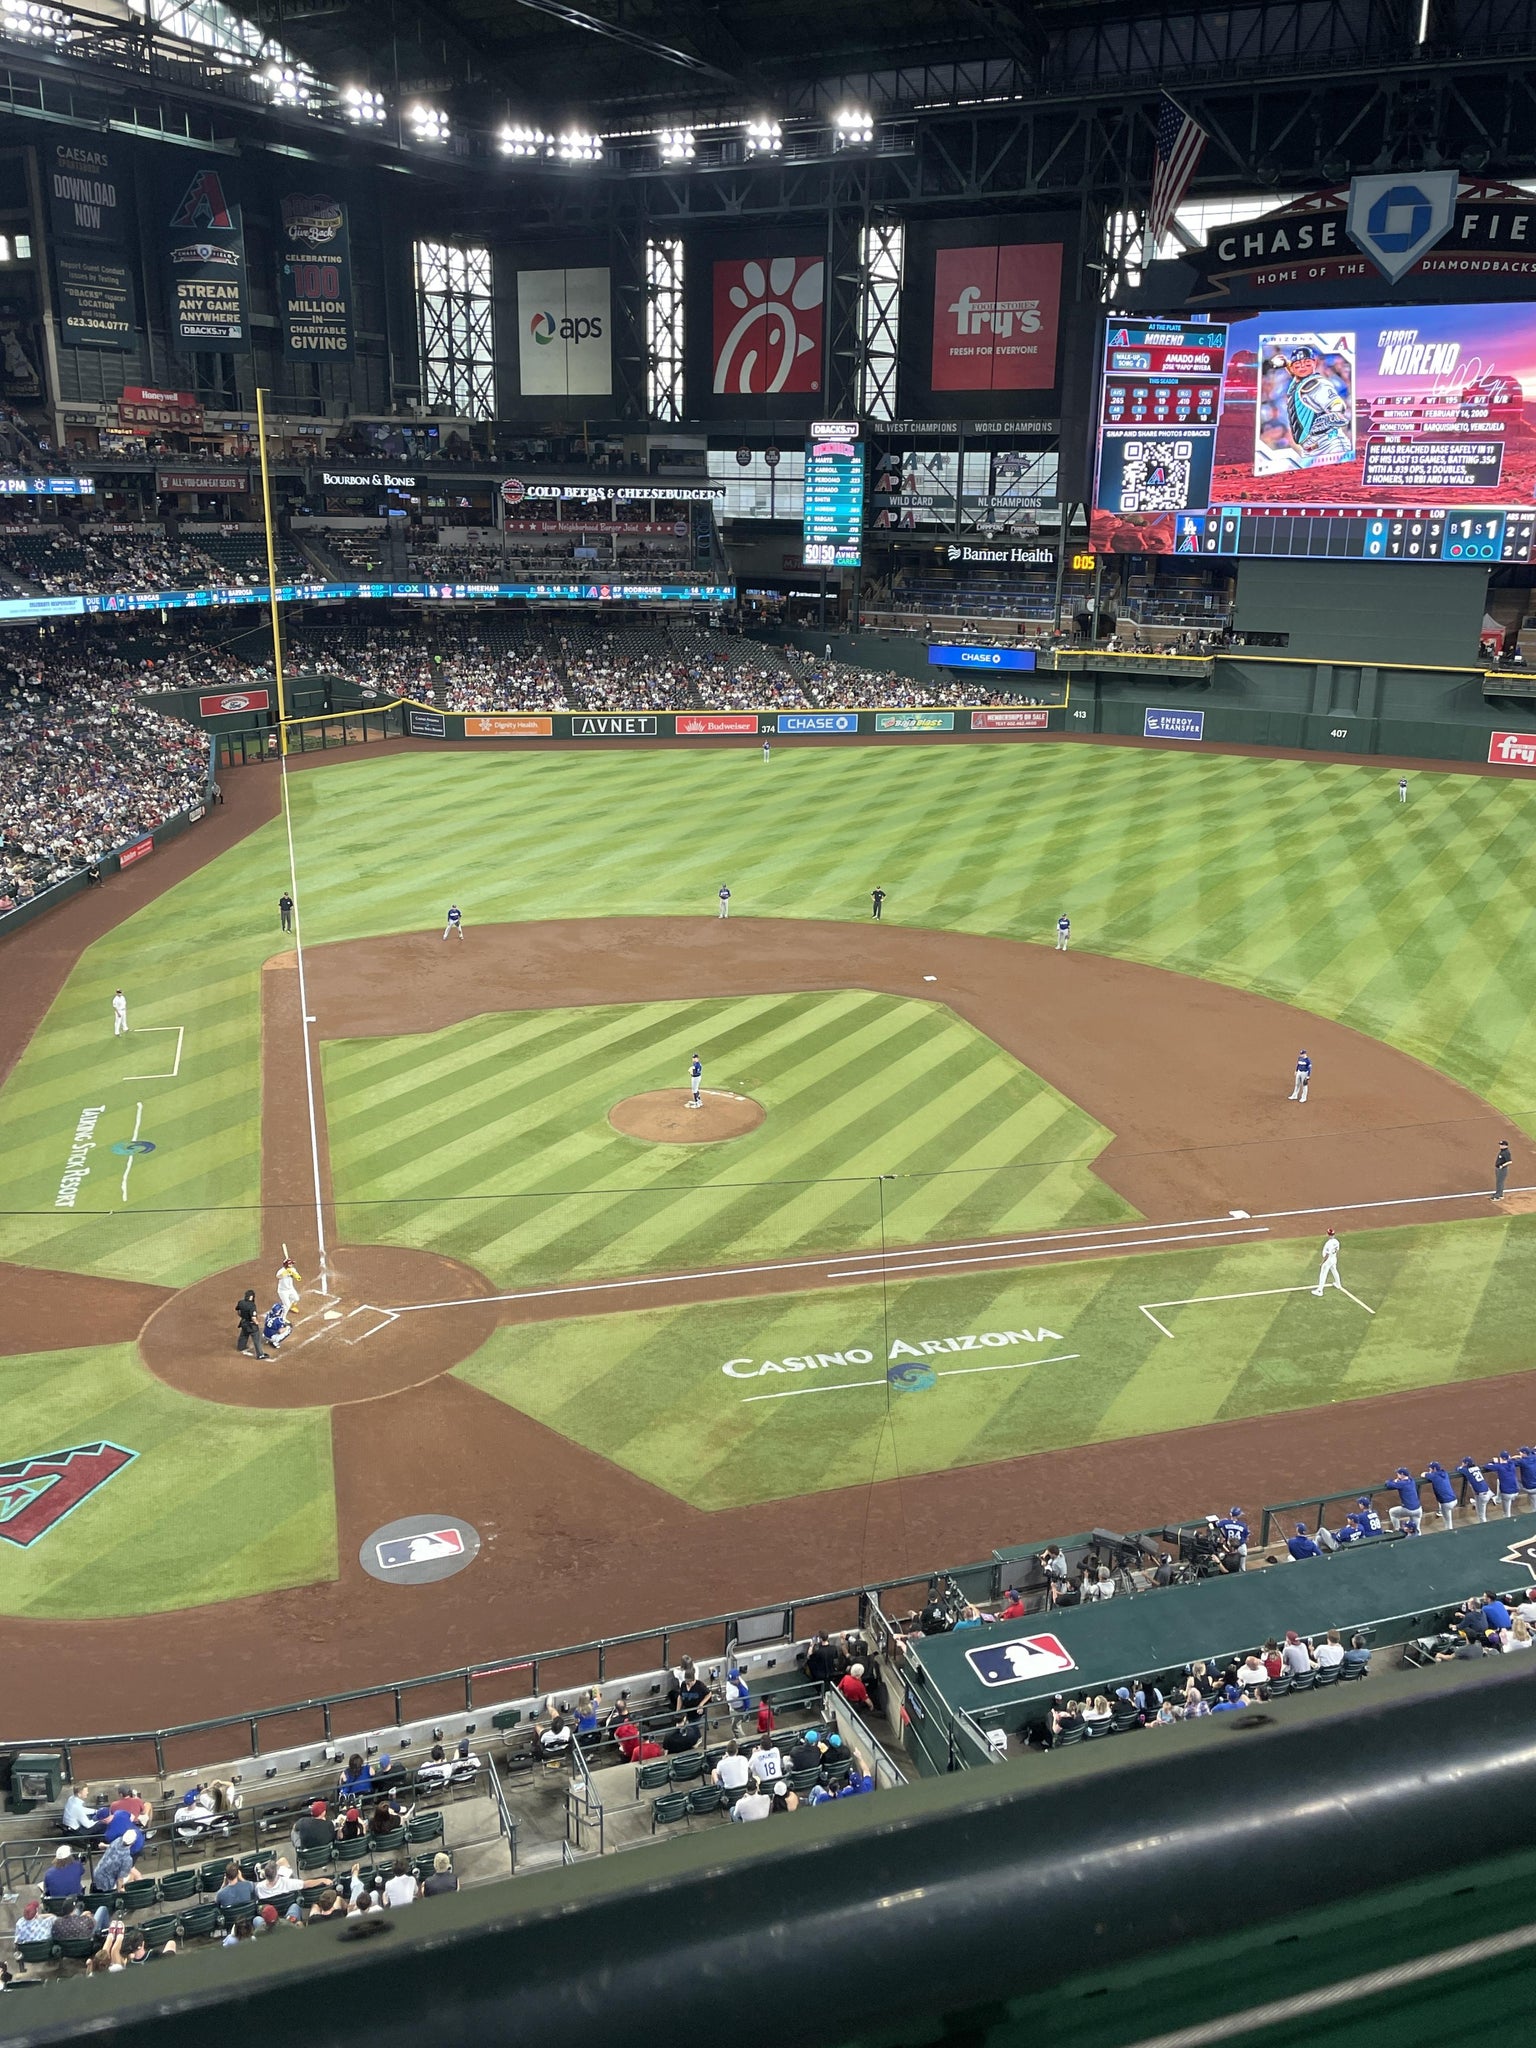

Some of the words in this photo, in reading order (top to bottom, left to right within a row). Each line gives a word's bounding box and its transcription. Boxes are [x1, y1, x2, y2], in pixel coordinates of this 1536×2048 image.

[56, 145, 109, 167] CAESARS
[53, 174, 117, 207] DOWNLOAD
[74, 203, 100, 229] NOW
[309, 226, 334, 242] Back
[1218, 222, 1336, 261] CHASE
[285, 254, 342, 263] CELEBRATING
[1257, 270, 1297, 284] HOME
[1309, 267, 1326, 277] OF
[1338, 264, 1365, 275] THE
[1422, 260, 1536, 272] DIAMONDBACKS
[177, 285, 239, 299] STREAM
[78, 299, 116, 310] LOCATION
[178, 300, 204, 310] ANY
[206, 300, 240, 311] GAME
[288, 301, 346, 313] MILLION
[1001, 301, 1036, 309] STORES
[180, 312, 241, 323] ANYWHERE
[312, 315, 324, 324] IN
[66, 317, 129, 331] 623.304.0777
[559, 315, 602, 344] aps
[183, 326, 227, 336] DBACKS.TV
[290, 325, 347, 335] CHARITABLE
[291, 336, 348, 351] GIVING
[1144, 333, 1185, 346] MORENO
[1207, 333, 1223, 348] 14
[1378, 330, 1418, 348] GABRIEL
[949, 347, 974, 356] FRESH
[976, 347, 993, 355] FOR
[995, 345, 1038, 355] EVERYONE
[1165, 354, 1194, 363] AMADO
[1378, 342, 1460, 376] MORENO
[141, 390, 178, 402] Honeywell
[1445, 396, 1458, 404] 195
[874, 423, 884, 432] NL
[887, 423, 907, 432] WEST
[911, 424, 957, 432] CHAMPIONS
[975, 423, 1002, 432] WORLD
[1004, 422, 1053, 431] CHAMPIONS
[1470, 423, 1504, 431] VENEZUELA
[1370, 446, 1380, 454] HE
[1420, 456, 1446, 465] GAMES,
[1368, 465, 1386, 473] WITH
[1409, 465, 1425, 475] OPS,
[1432, 465, 1467, 474] DOUBLES,
[219, 479, 236, 487] SEATS
[323, 473, 369, 486] BOURBON
[372, 474, 383, 486] &
[384, 474, 416, 486] BONES
[1373, 475, 1404, 484] HOMERS,
[1415, 475, 1427, 483] RBI
[1427, 475, 1442, 483] AND
[1449, 475, 1475, 484] WALKS
[8, 480, 27, 491] PM
[527, 487, 561, 497] COLD
[564, 487, 604, 499] BEERS
[607, 488, 615, 498] &
[617, 489, 724, 499] CHEESEBURGERS
[889, 496, 910, 505] WILD
[911, 496, 934, 506] CARD
[977, 497, 989, 507] NL
[991, 497, 1042, 507] CHAMPIONS
[1430, 510, 1445, 518] LOB
[6, 526, 28, 534] BAR-S
[113, 525, 133, 533] BAR-S
[541, 523, 556, 533] Your
[558, 523, 598, 533] Neighborhood
[601, 523, 621, 533] Burger
[622, 523, 639, 532] Joint
[1208, 521, 1217, 532] 0
[1225, 521, 1234, 532] 0
[1372, 522, 1383, 535] 0
[1393, 523, 1402, 535] 2
[1411, 524, 1421, 535] 0
[1431, 525, 1440, 537] 3
[1451, 524, 1457, 534] B
[1460, 519, 1472, 539] 1
[1475, 525, 1482, 535] S
[1485, 520, 1497, 539] 1
[1506, 526, 1515, 537] 2
[1520, 527, 1530, 538] 4
[1207, 540, 1216, 551] 0
[1370, 541, 1380, 554] 0
[1392, 542, 1400, 554] 1
[1409, 543, 1419, 554] 0
[1429, 543, 1437, 555] 1
[1503, 545, 1512, 557] 2
[1517, 545, 1528, 557] 4
[963, 548, 1007, 562] Banner
[1011, 549, 1053, 562] Health
[1073, 555, 1095, 570] 0:05
[397, 584, 419, 593] COX
[961, 653, 992, 662] CHASE
[1073, 710, 1087, 719] 413
[494, 721, 516, 729] Dignity
[582, 717, 648, 733] AVNET
[708, 721, 751, 731] Budweiser
[787, 718, 834, 729] CHASE
[1160, 716, 1192, 726] ENERGY
[761, 725, 776, 733] 374
[1160, 724, 1200, 733] TRANSFER
[1330, 729, 1347, 739] 407
[74, 1105, 106, 1142] TALKING
[66, 1142, 97, 1167] STICK
[54, 1167, 90, 1208] RESORT
[721, 1348, 874, 1379] CASINO
[888, 1326, 1065, 1360] ARIZONA
[763, 1761, 776, 1777] 18
